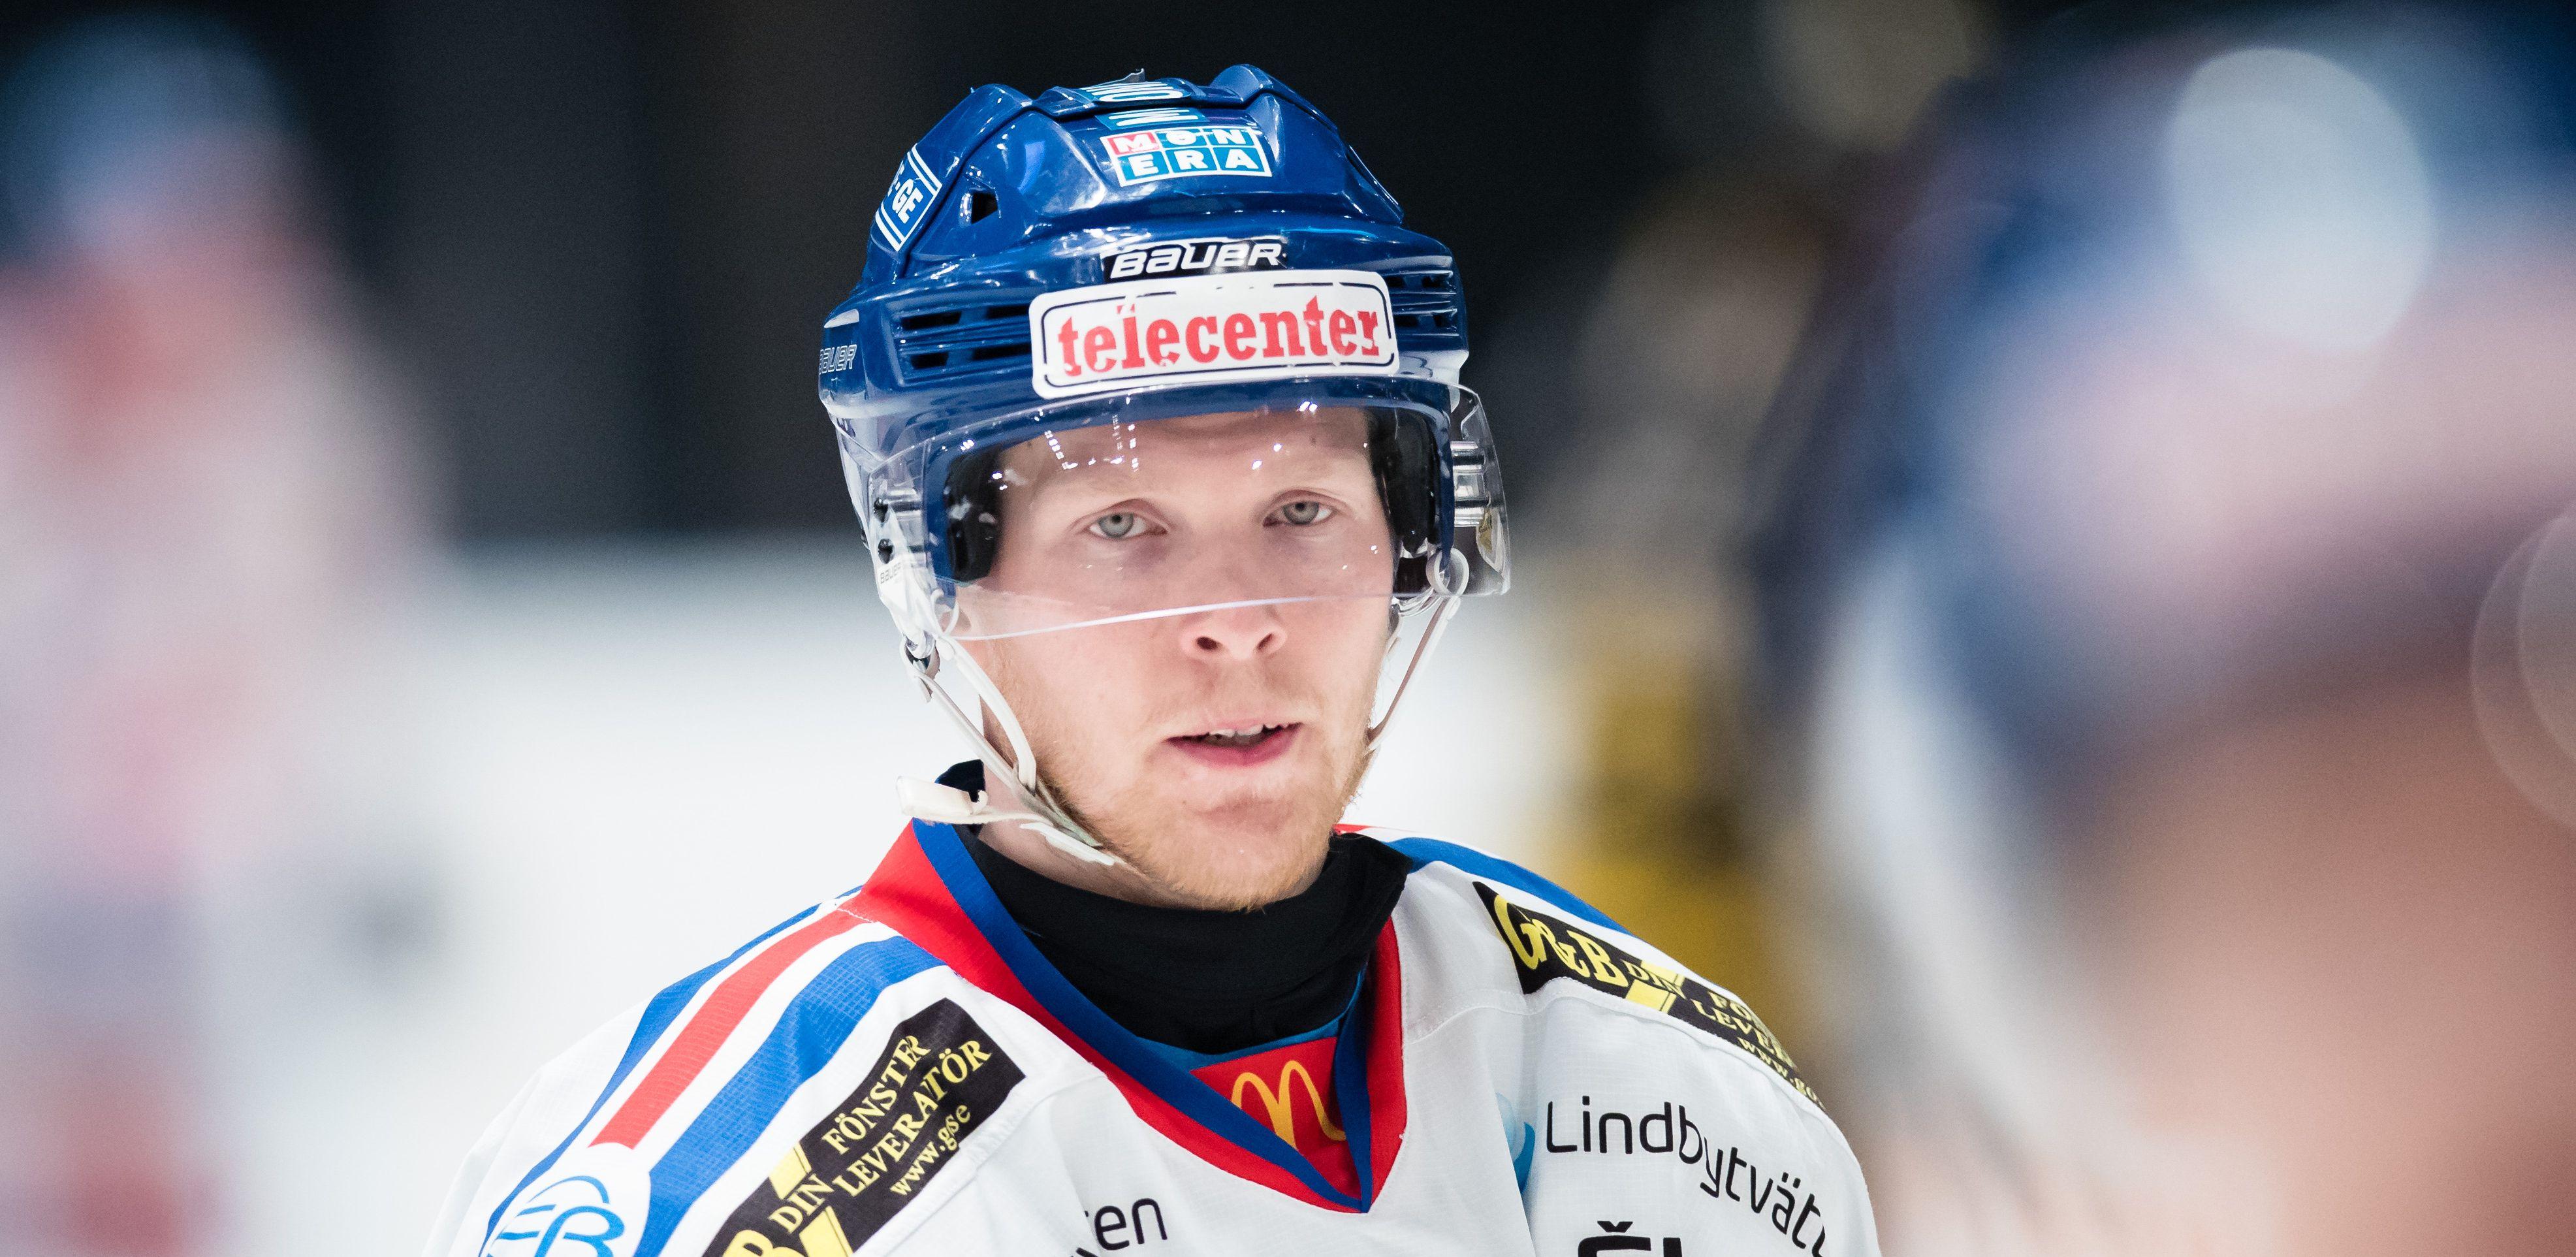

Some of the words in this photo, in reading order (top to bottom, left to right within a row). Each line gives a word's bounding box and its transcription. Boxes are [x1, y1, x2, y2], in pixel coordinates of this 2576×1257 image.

[1128, 150, 1259, 177] ERA
[1111, 241, 1284, 279] BAUER
[1057, 295, 1380, 377] telecenter
[833, 1040, 993, 1197] LEVERATÖR
[768, 1173, 835, 1234] DIN
[1085, 1198, 1168, 1250] en
